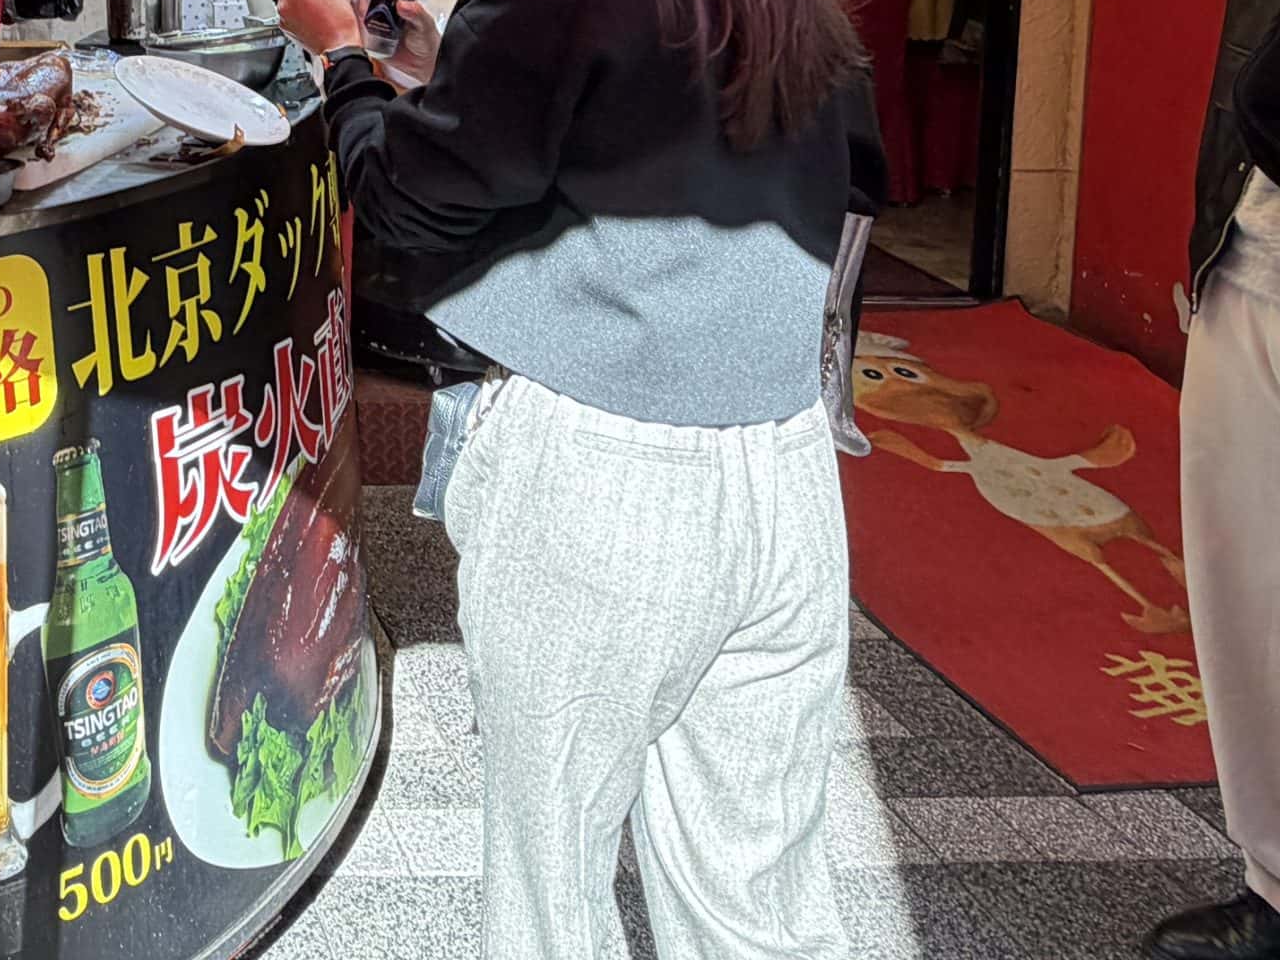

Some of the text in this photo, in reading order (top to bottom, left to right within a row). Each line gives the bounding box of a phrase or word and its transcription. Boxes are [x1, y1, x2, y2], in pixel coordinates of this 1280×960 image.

[57, 516, 108, 544] TSINGTAO
[63, 687, 139, 740] TSINGTAO
[57, 832, 174, 921] 500円
